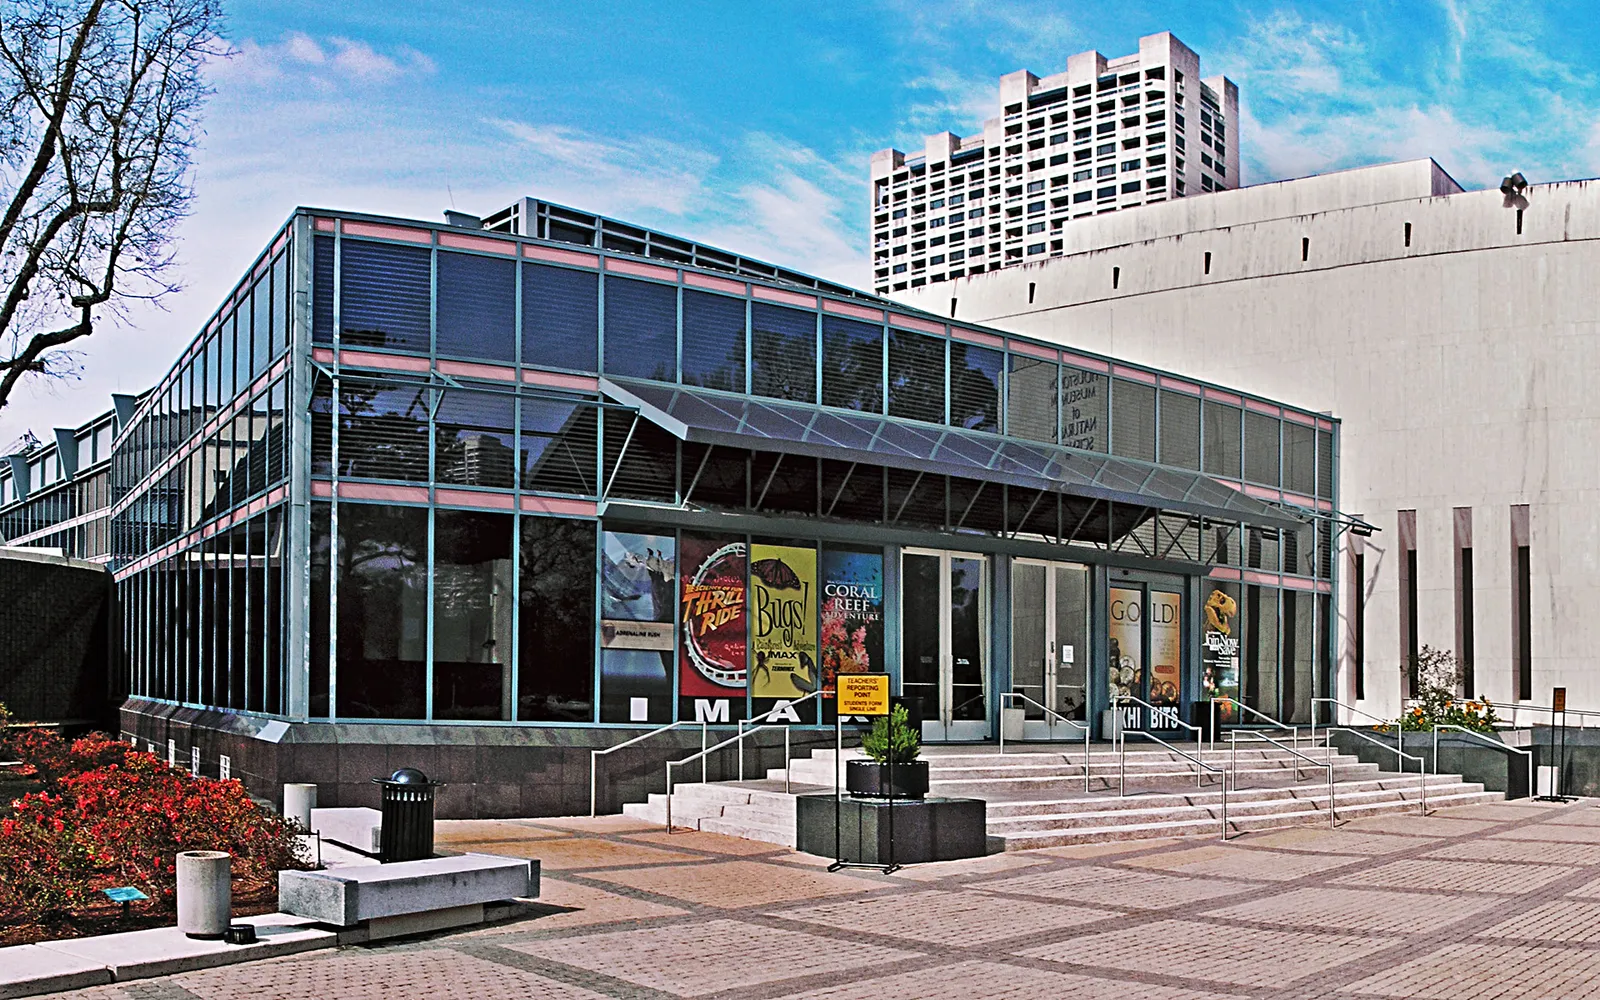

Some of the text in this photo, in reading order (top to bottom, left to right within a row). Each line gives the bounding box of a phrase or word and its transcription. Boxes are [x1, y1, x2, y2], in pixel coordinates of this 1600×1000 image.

[824, 584, 878, 599] CORAL
[682, 590, 744, 623] THRILL
[834, 598, 870, 612] REEF
[700, 605, 743, 637] RIDE
[754, 581, 809, 648] Bugs!
[825, 611, 879, 621] ADVENTURE
[768, 651, 797, 660] IMAX
[846, 684, 879, 692] REPORTING
